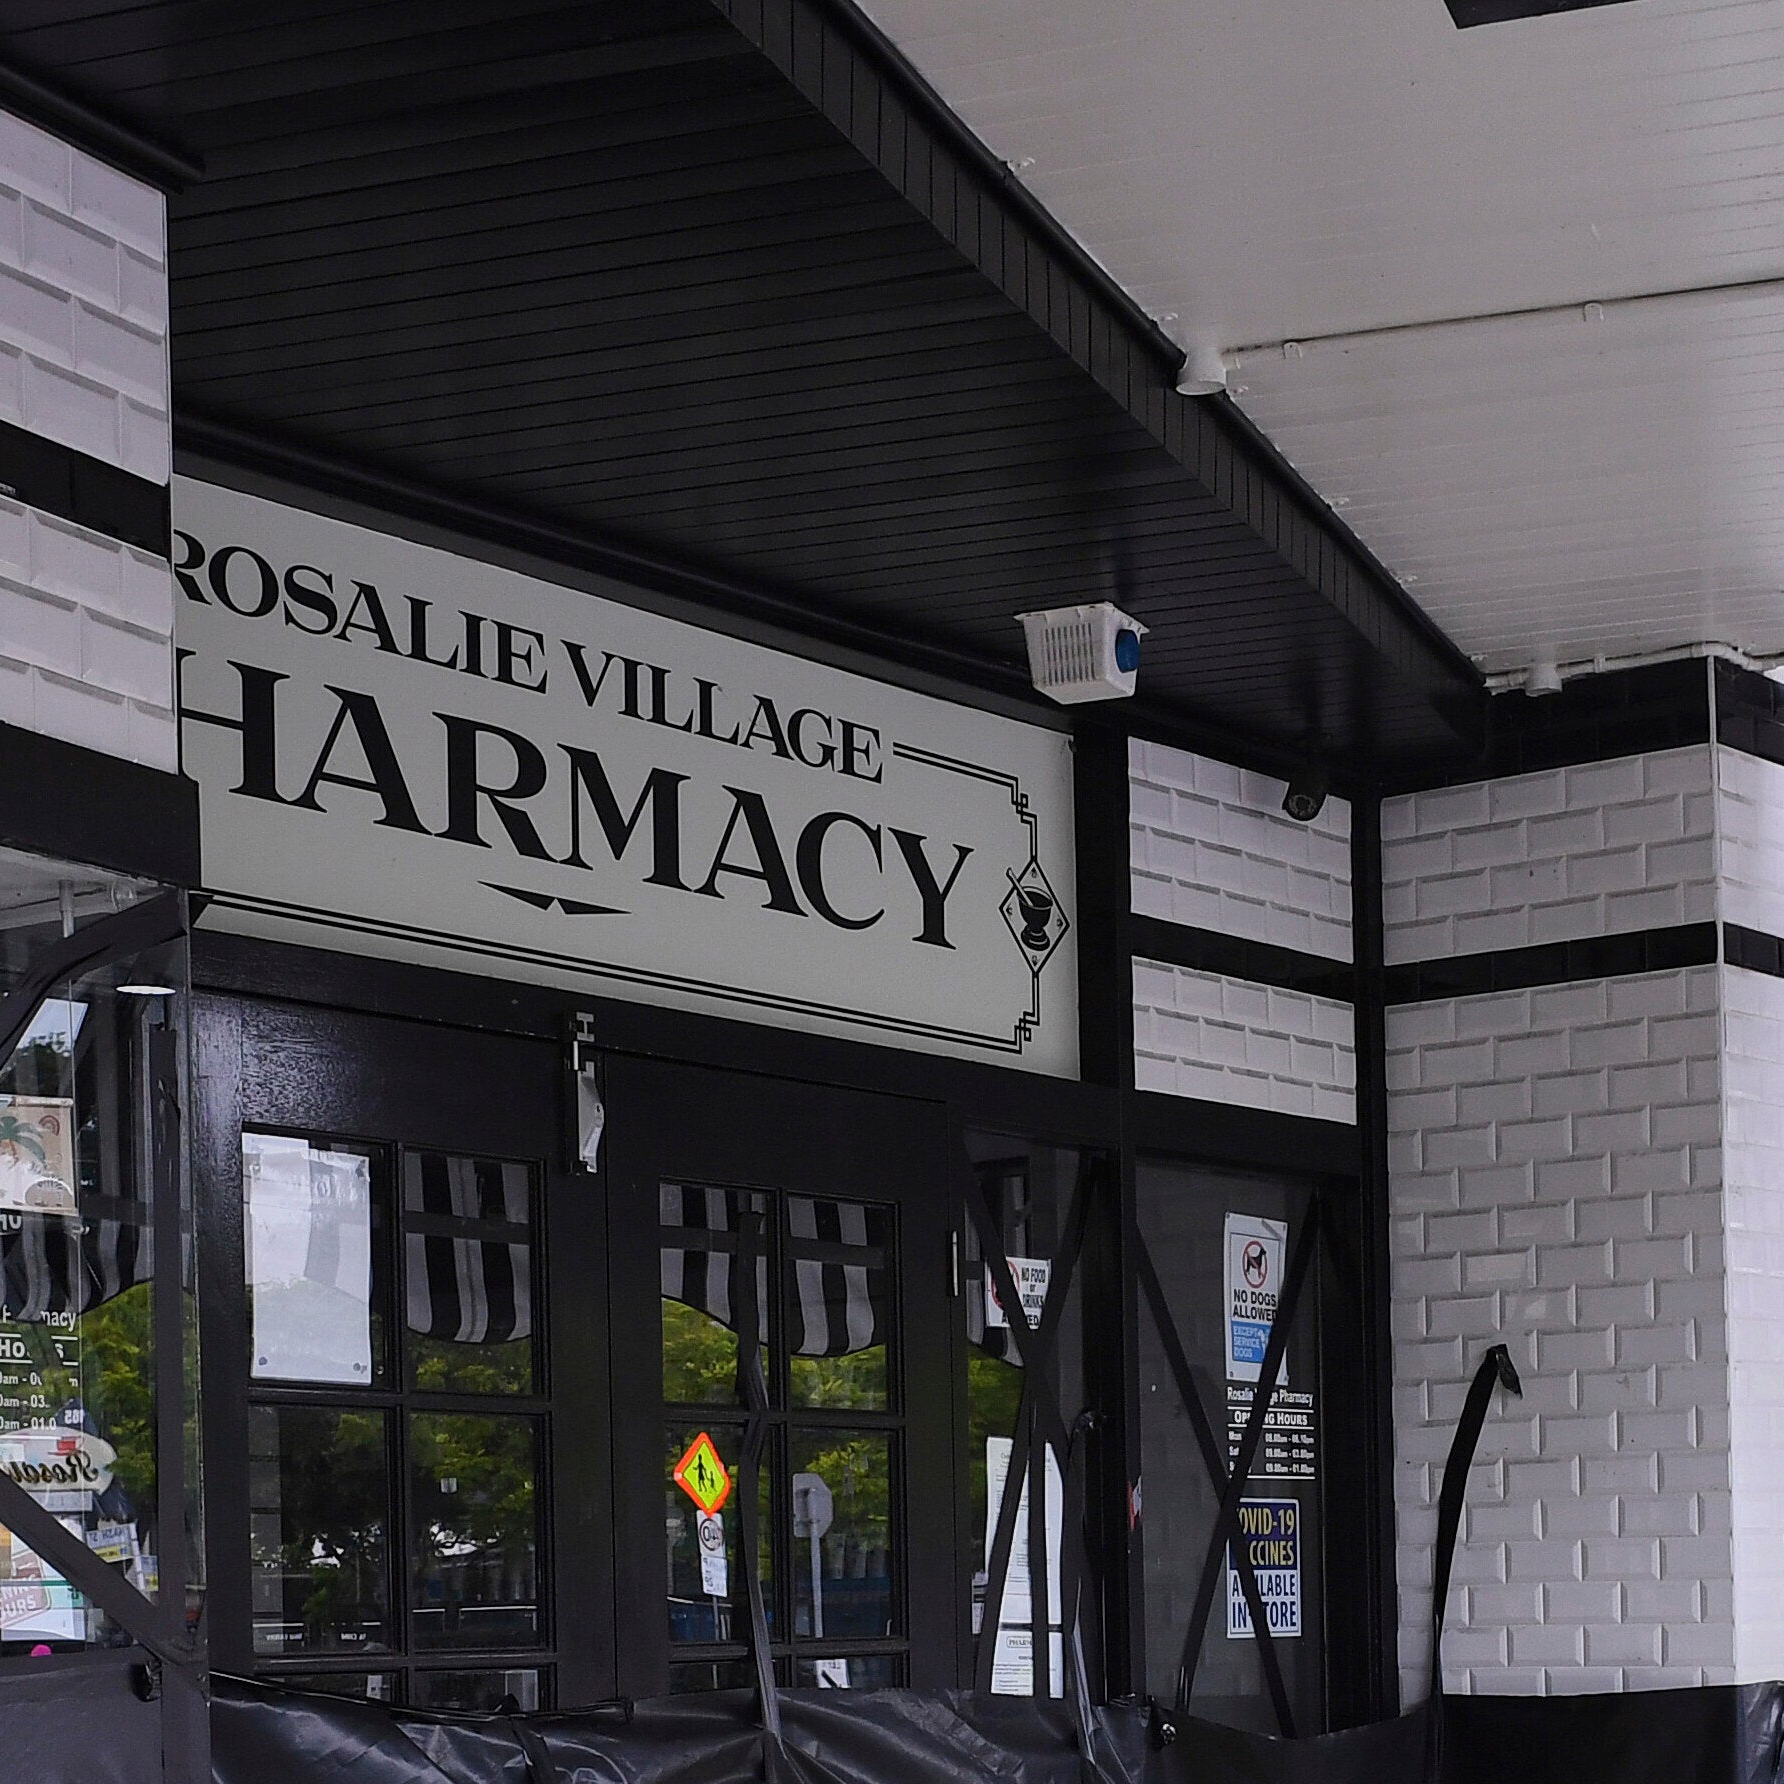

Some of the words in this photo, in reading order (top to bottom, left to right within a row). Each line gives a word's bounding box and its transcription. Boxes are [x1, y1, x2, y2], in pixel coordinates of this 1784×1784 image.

[173, 528, 549, 695] ROSALIE
[560, 638, 885, 784] VILLAGE
[178, 648, 975, 951] HARMACY
[1233, 1288, 1248, 1303] NO
[1250, 1291, 1277, 1307] DOGS
[30, 1417, 57, 1432] 01.0
[1277, 1412, 1308, 1425] HOURS
[1238, 1507, 1295, 1535] OVID-19
[1249, 1540, 1295, 1566] CCINES
[1232, 1574, 1296, 1597] ALABLE
